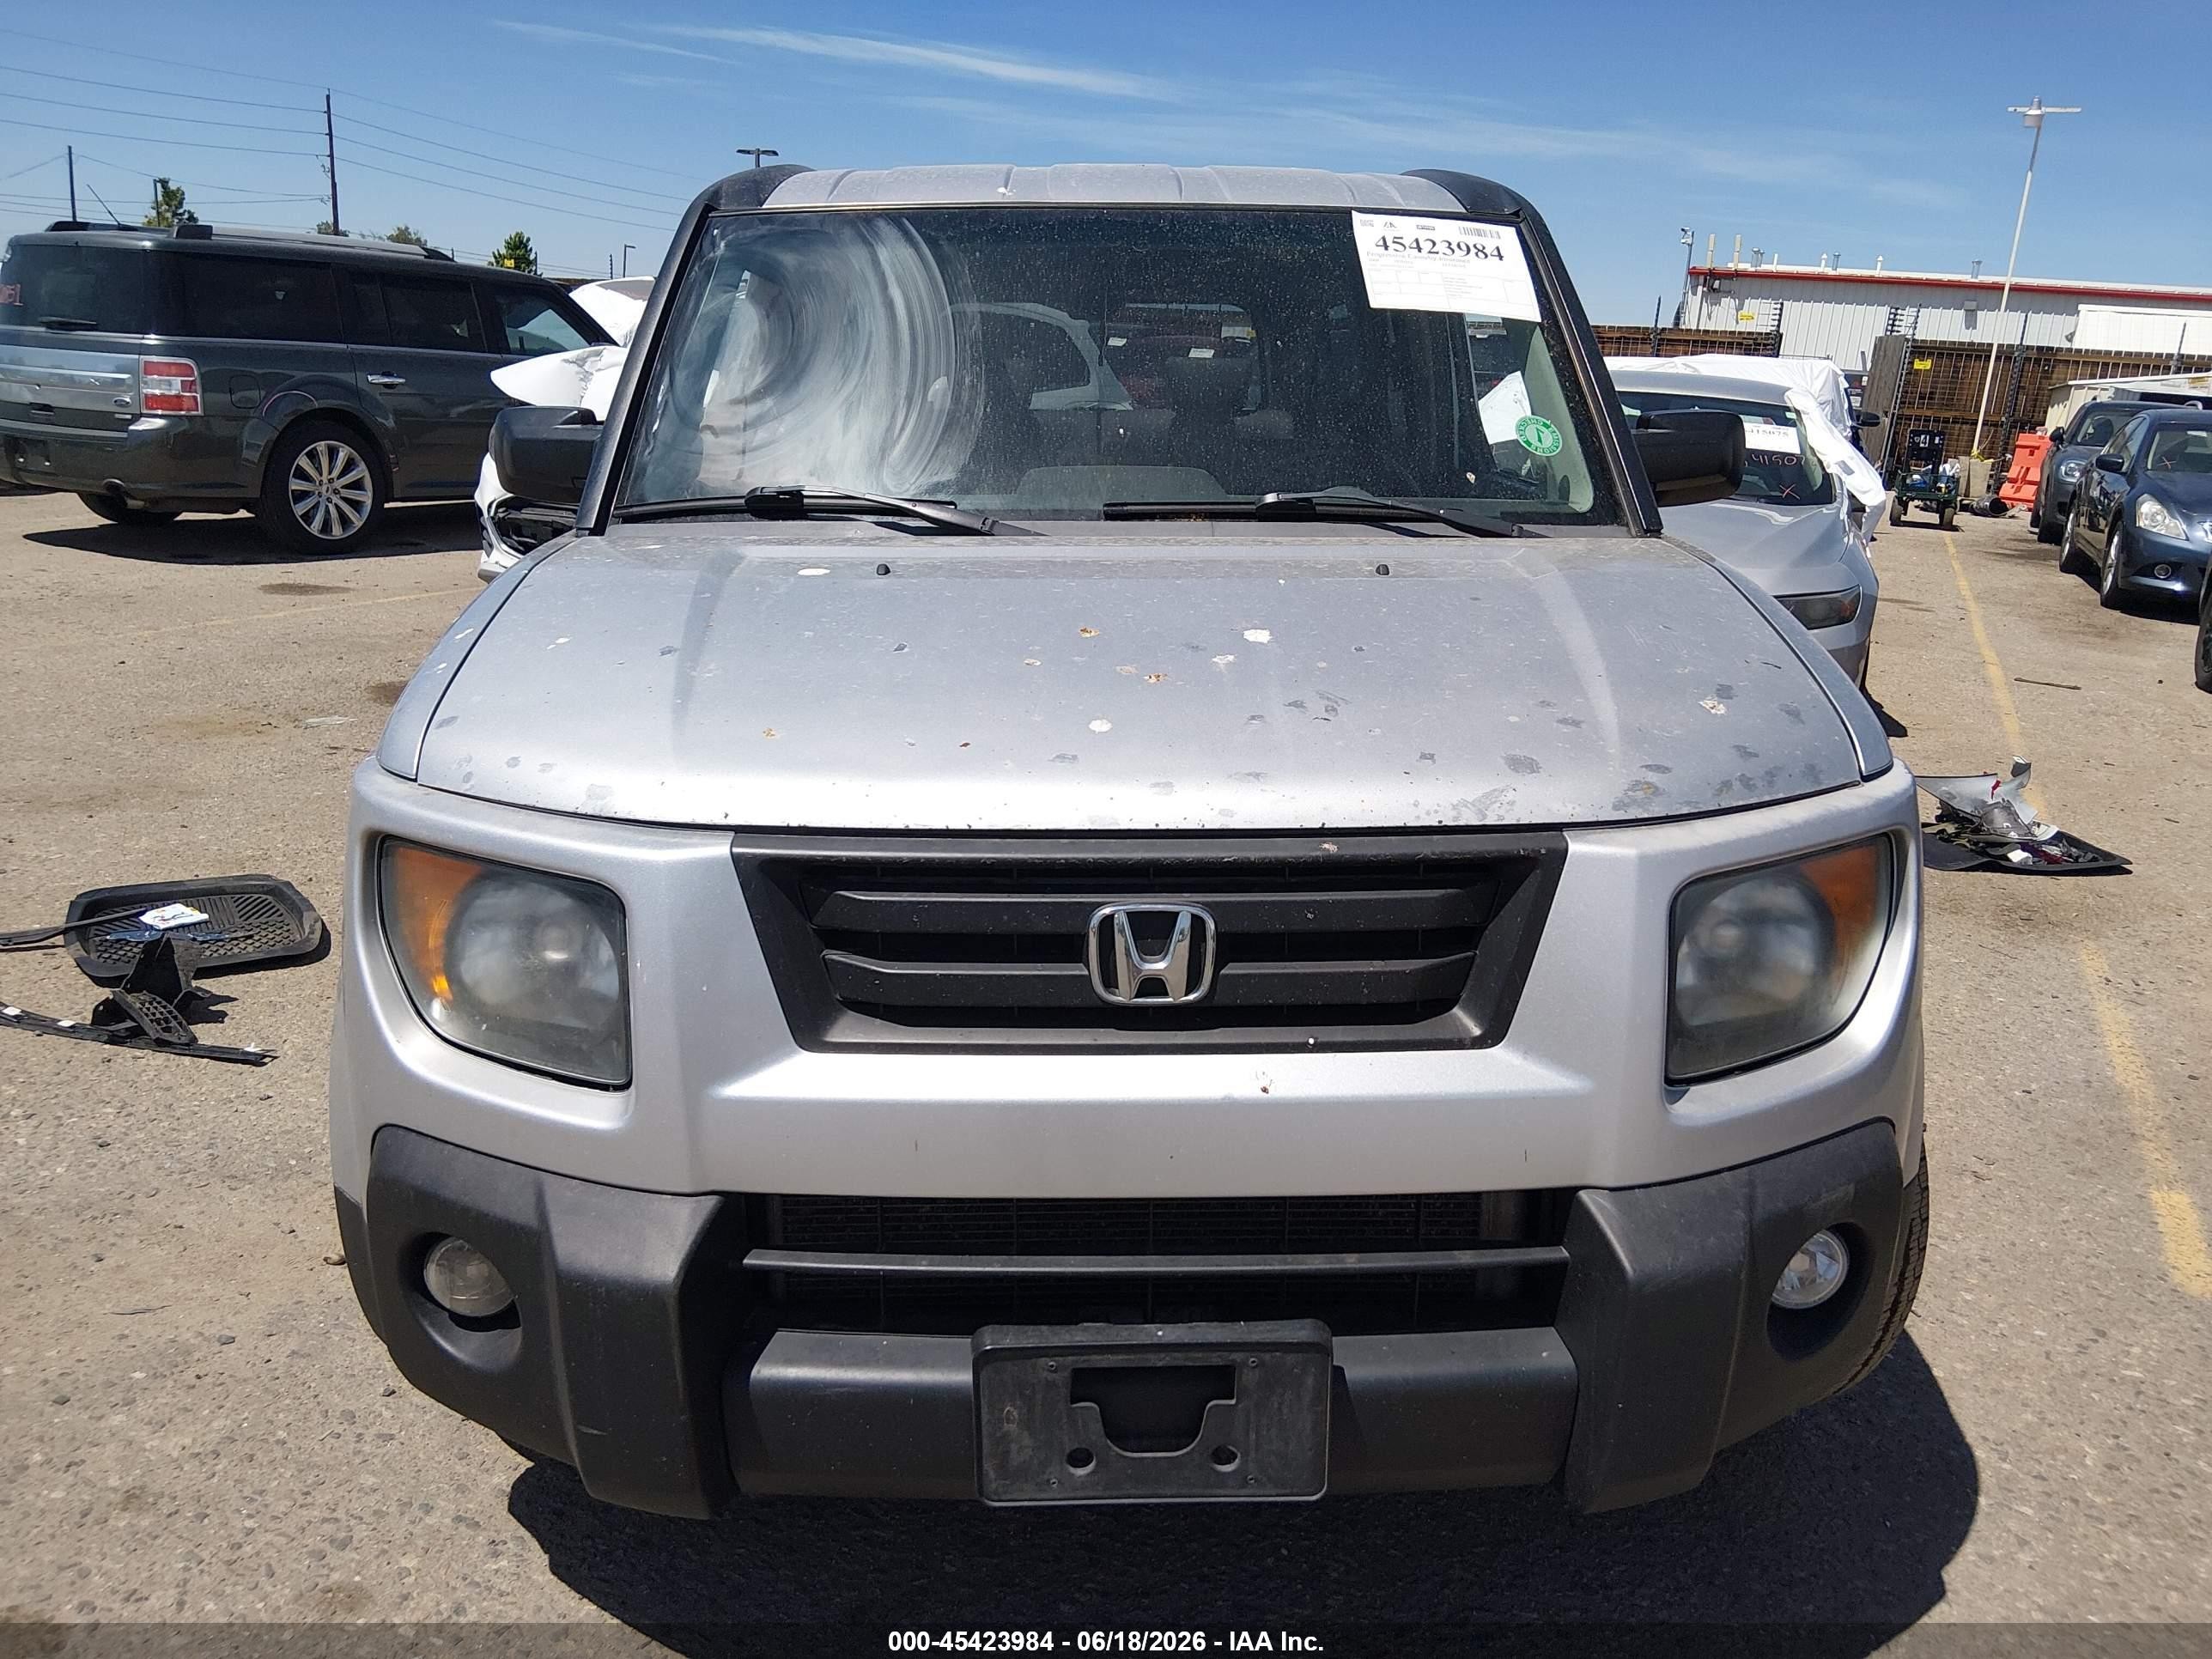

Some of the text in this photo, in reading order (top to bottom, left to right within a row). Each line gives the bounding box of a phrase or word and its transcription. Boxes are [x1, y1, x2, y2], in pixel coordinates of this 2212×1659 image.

[1375, 234, 1504, 261] 45423984
[1519, 418, 1543, 441] CHECKED
[1530, 427, 1560, 453] EMISSIONS
